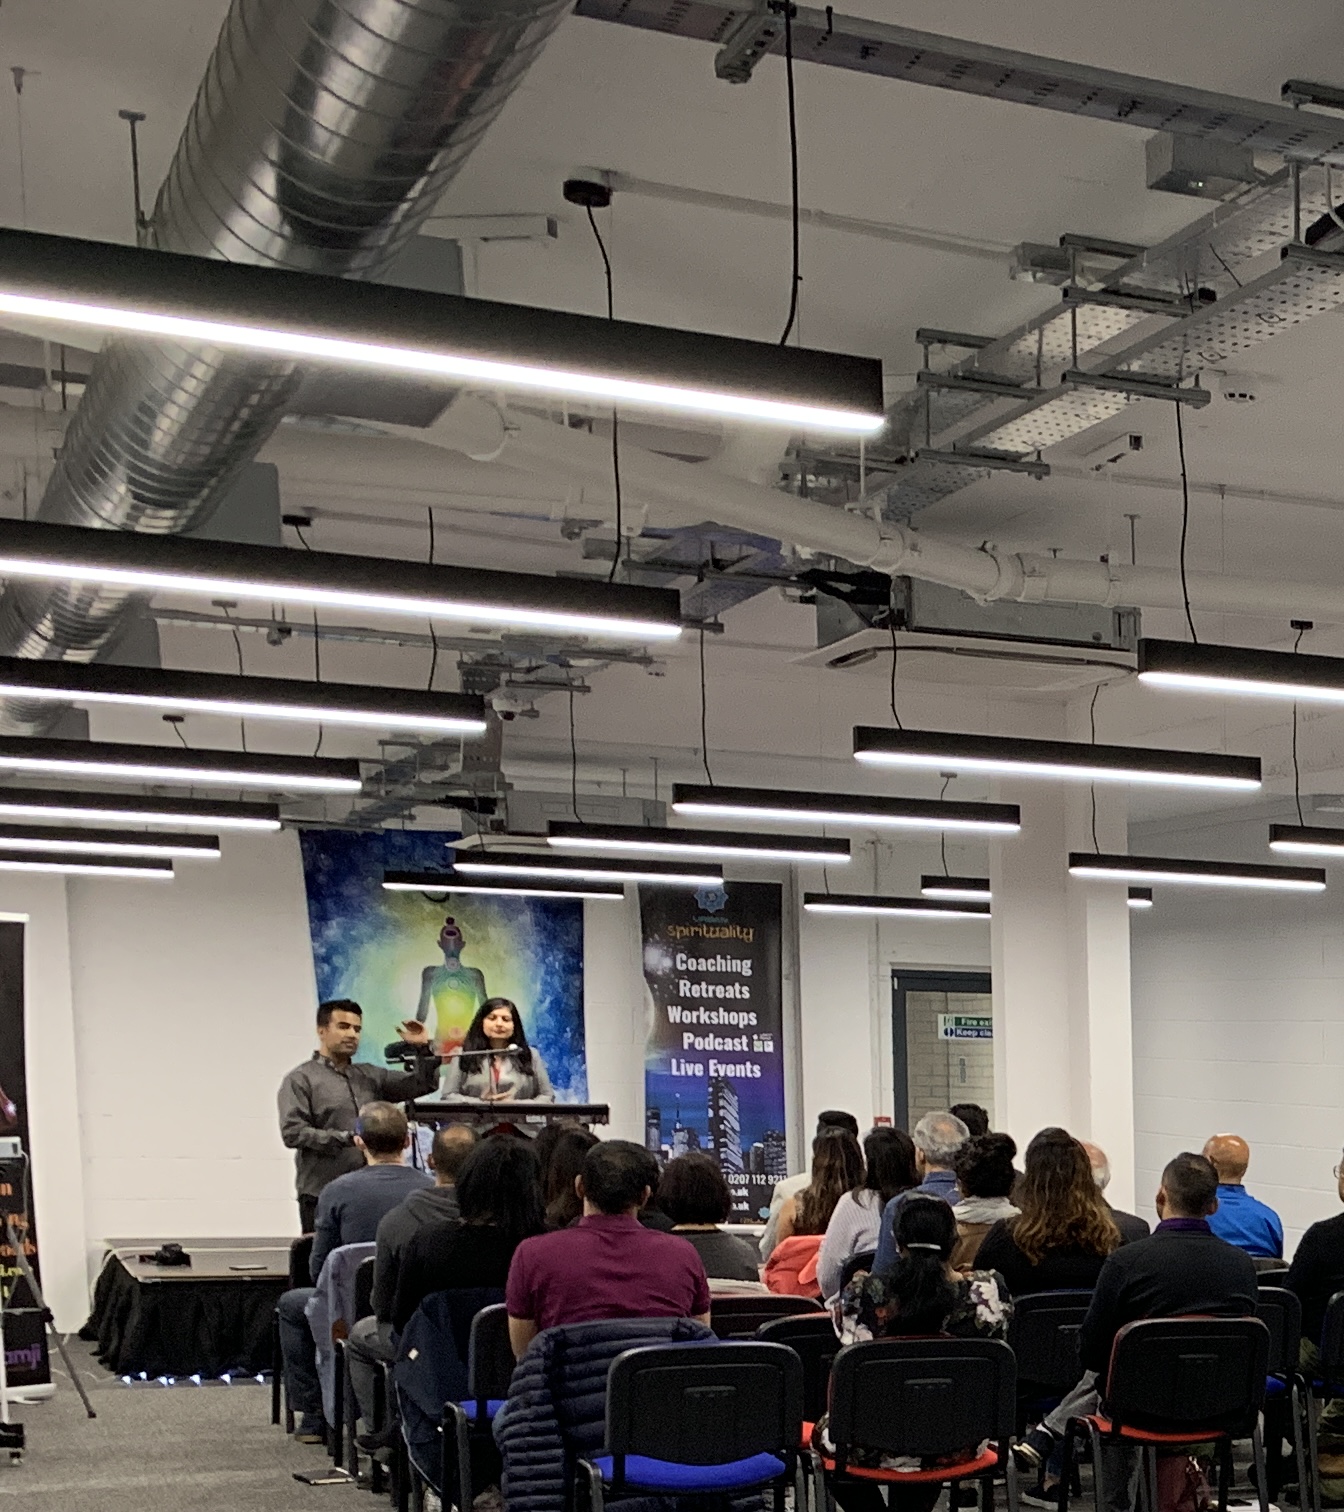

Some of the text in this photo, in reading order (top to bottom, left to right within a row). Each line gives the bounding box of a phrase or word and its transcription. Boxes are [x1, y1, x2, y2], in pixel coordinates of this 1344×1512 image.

[667, 924, 755, 943] spirituality
[675, 953, 753, 977] Coaching
[679, 979, 751, 999] Retreats
[667, 1005, 758, 1029] Workshops
[682, 1032, 749, 1052] Podcast
[956, 1029, 978, 1038] Keep
[671, 1058, 761, 1078] Live Events
[728, 1173, 750, 1185] 0207
[752, 1174, 767, 1185] 112
